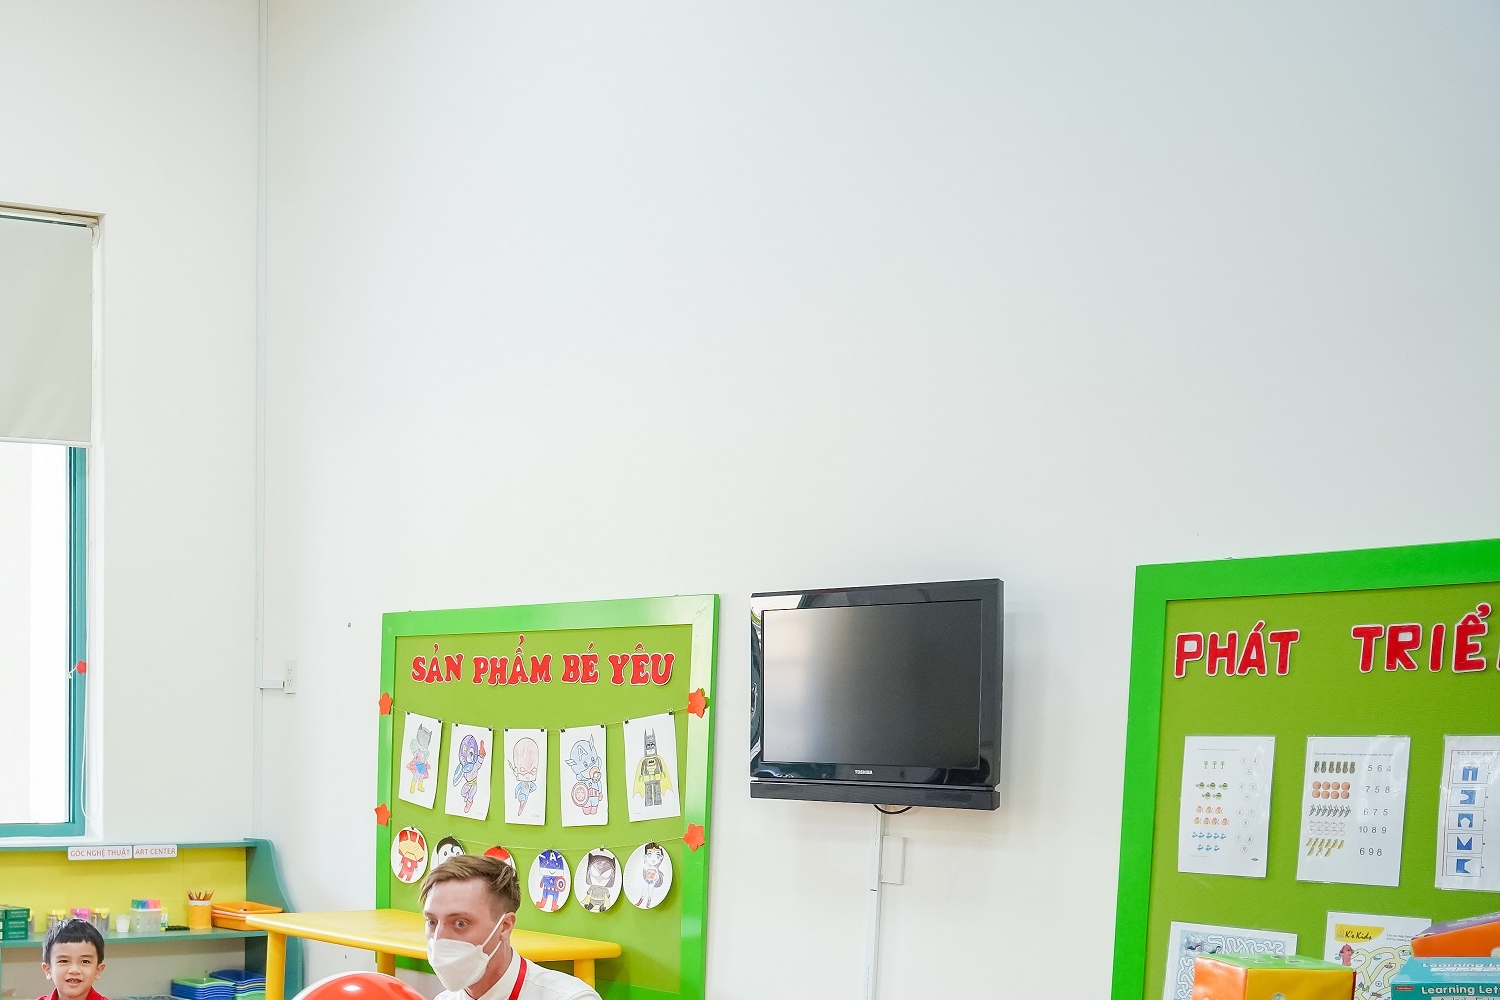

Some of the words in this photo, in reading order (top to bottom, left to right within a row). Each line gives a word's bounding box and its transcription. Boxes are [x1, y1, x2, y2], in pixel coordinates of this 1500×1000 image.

[1174, 620, 1300, 678] PHÁT
[1351, 602, 1500, 673] TRIỂ
[411, 642, 464, 684] SẢN
[472, 634, 552, 686] PHẨM
[561, 642, 599, 685] BÉ
[608, 642, 676, 686] YÊU
[1367, 764, 1373, 772] 5
[1377, 764, 1383, 772] 6
[1363, 808, 1369, 816] 6
[1372, 808, 1378, 816] 7
[1371, 826, 1377, 834] 8
[1381, 826, 1387, 834] 9
[70, 849, 85, 857] GÓC
[86, 849, 105, 858] NGHỆ
[107, 848, 130, 857] THUẬT
[1359, 847, 1365, 855] 6
[1368, 847, 1374, 856] 9
[1376, 848, 1383, 856] 8
[1421, 985, 1475, 996] Learning
[1479, 985, 1500, 994] Let
